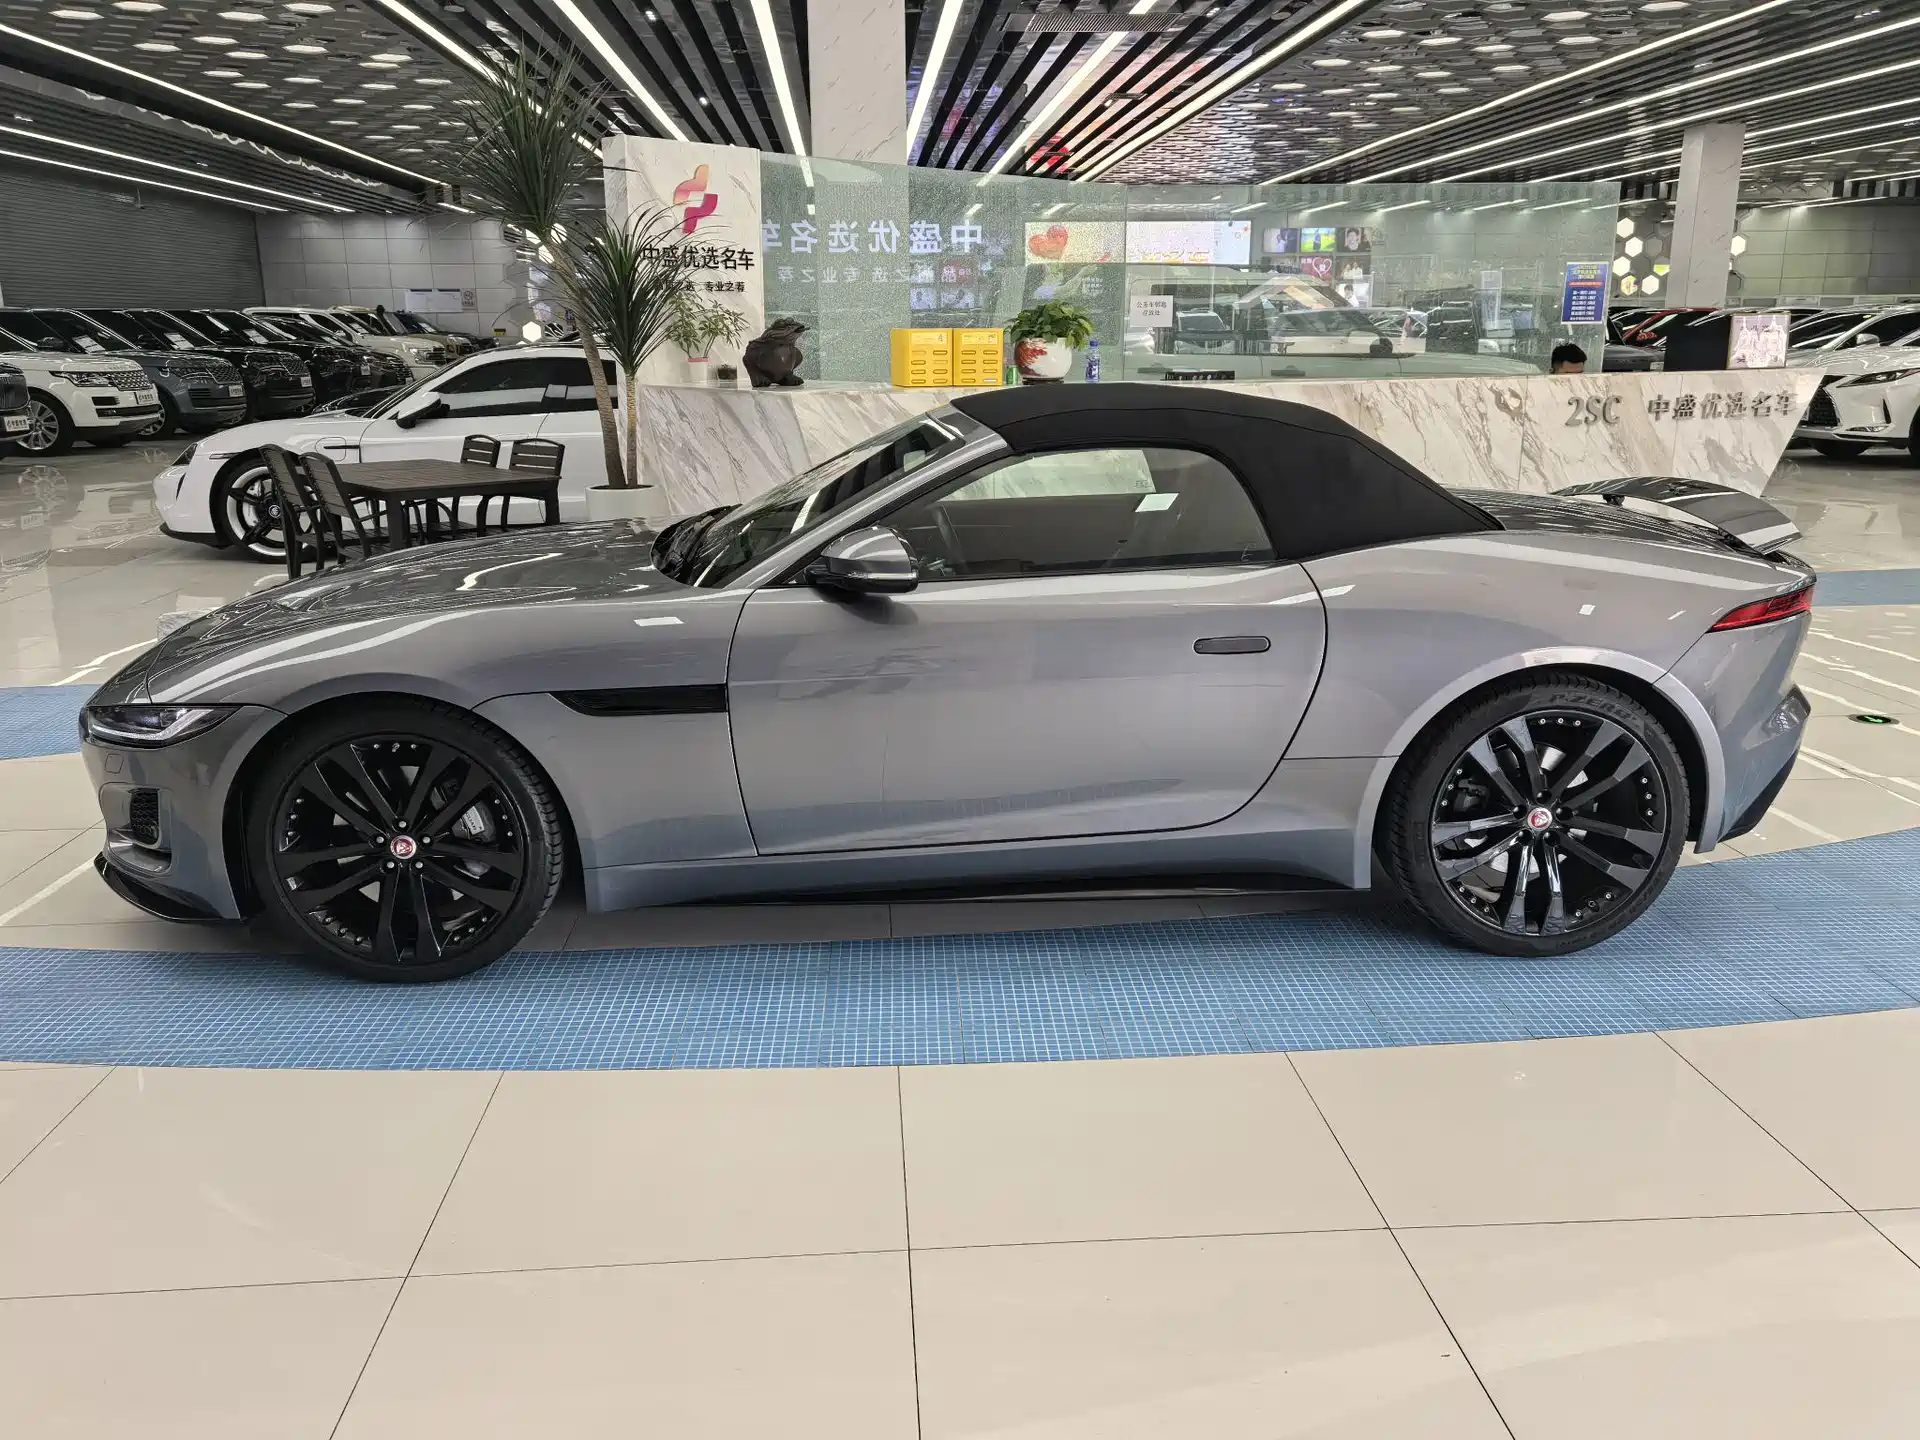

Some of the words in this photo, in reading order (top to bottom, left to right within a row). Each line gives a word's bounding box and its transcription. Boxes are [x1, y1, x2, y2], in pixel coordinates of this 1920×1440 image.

[642, 244, 755, 270] 中盛优选名车
[1565, 395, 1622, 426] 2SC
[1648, 389, 1798, 421] 中盛优选名车
